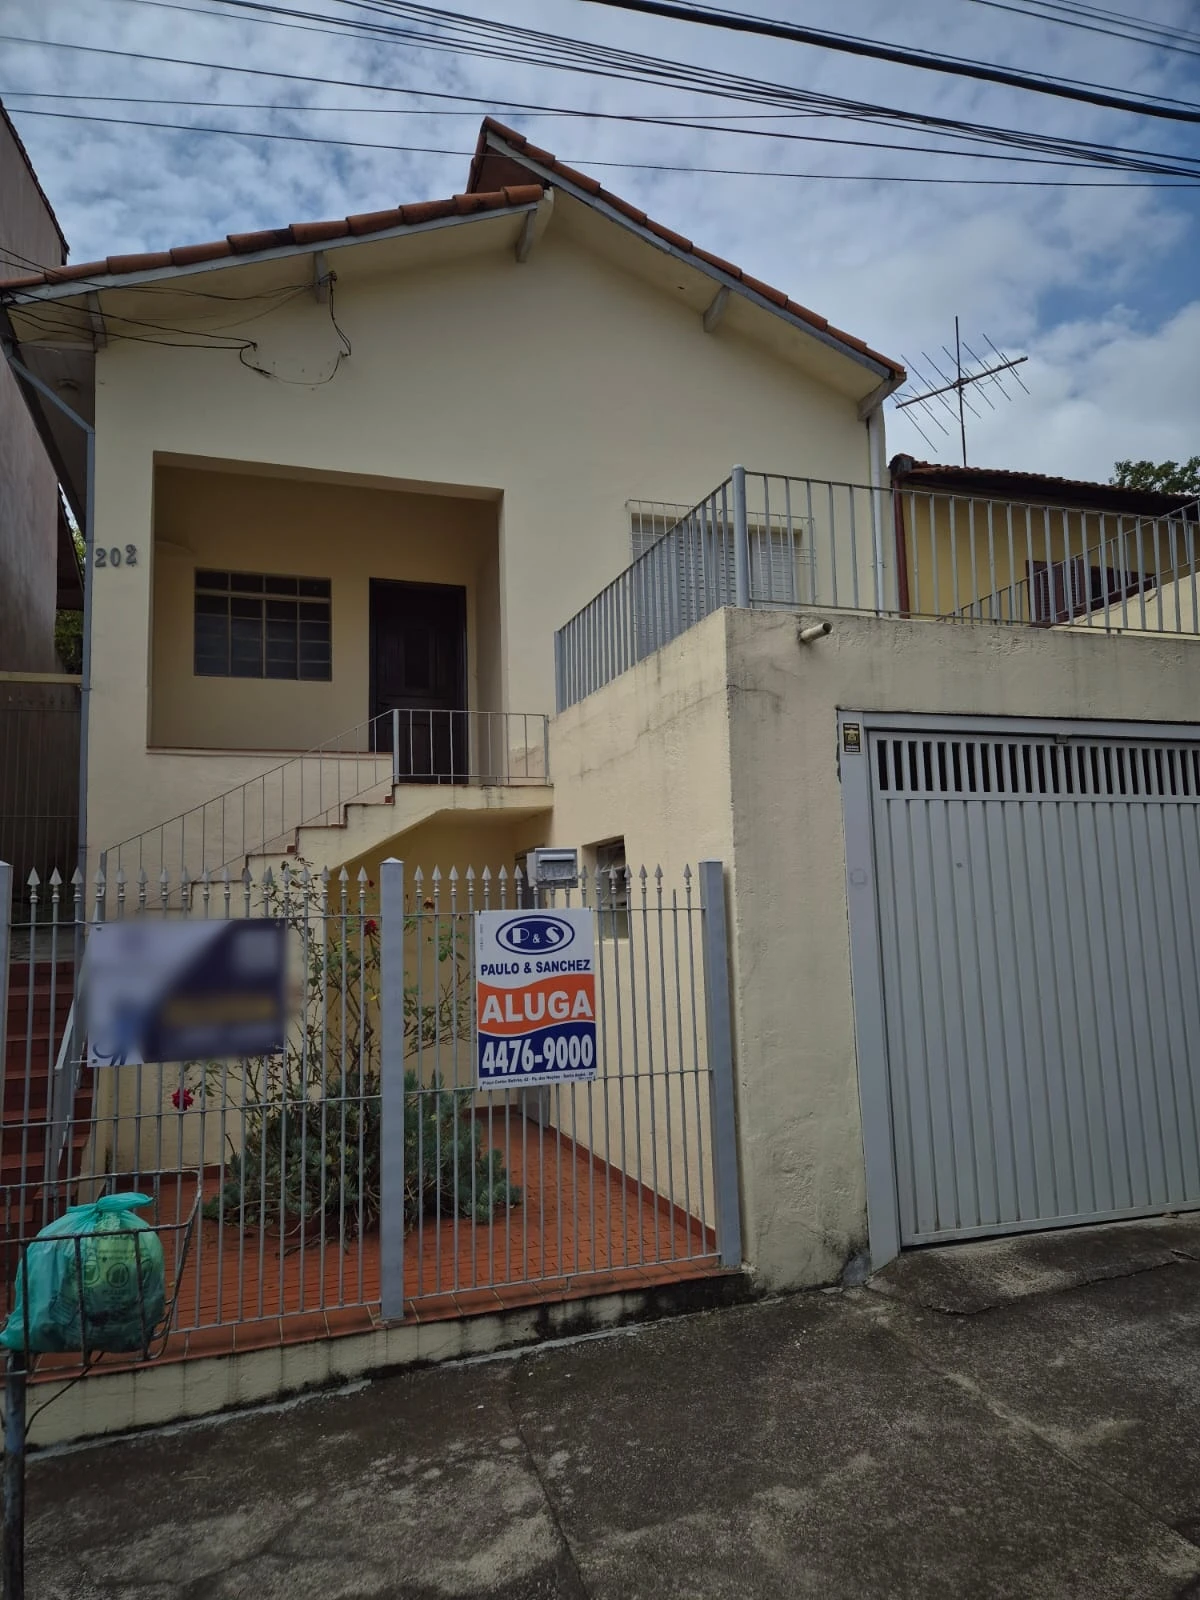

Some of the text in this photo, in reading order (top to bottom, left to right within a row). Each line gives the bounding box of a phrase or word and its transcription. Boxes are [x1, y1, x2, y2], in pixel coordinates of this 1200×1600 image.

[95, 544, 137, 568] 202
[512, 926, 560, 944] P & S
[481, 959, 591, 976] PAULO & SANCHEZ
[480, 989, 593, 1024] ALUGA
[481, 1033, 594, 1075] 4476-9000
